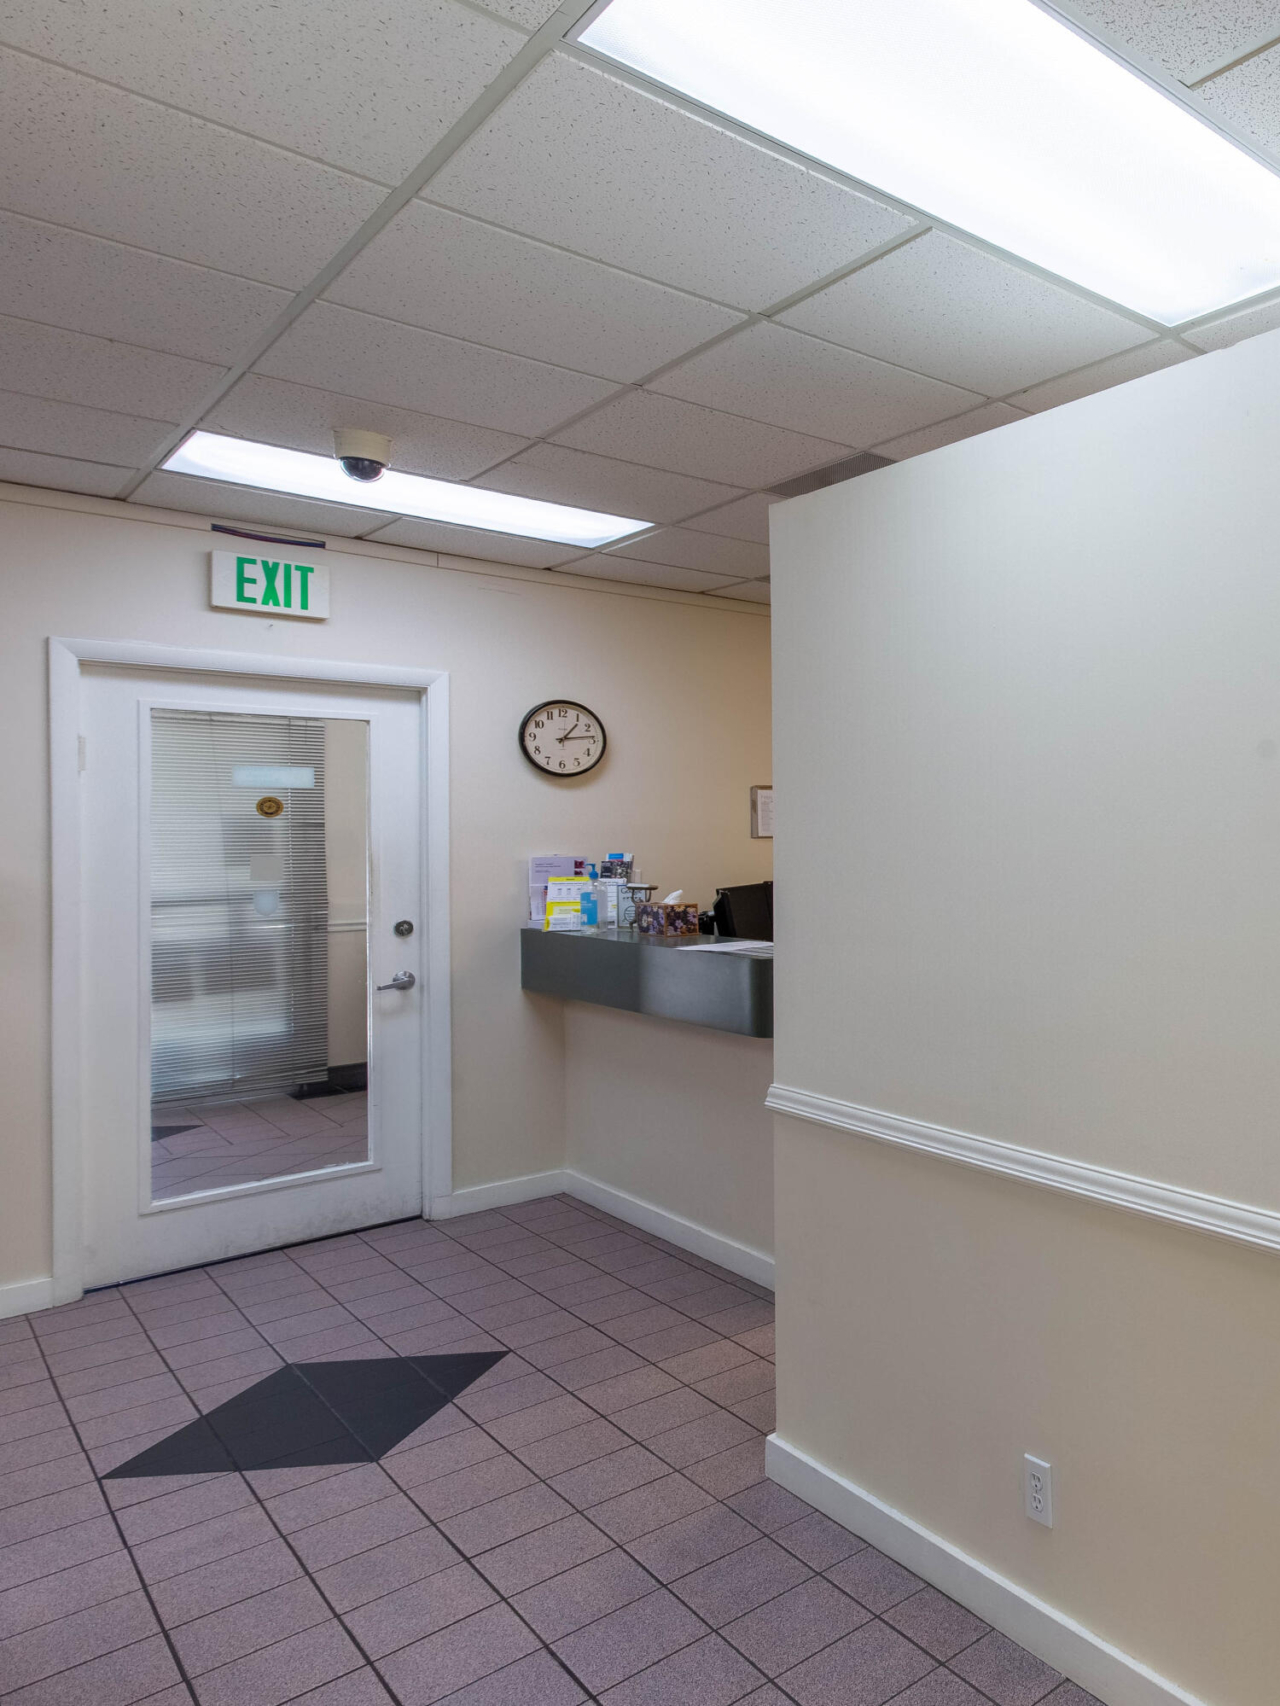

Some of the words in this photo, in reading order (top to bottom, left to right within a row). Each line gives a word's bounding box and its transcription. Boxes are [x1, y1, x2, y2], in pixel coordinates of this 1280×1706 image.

[236, 556, 314, 610] EXIT
[546, 711, 553, 720] 11
[558, 709, 567, 718] 12
[576, 713, 580, 722] 1
[534, 720, 544, 729] 10
[584, 723, 591, 732] 2
[529, 732, 536, 741] 9
[588, 736, 596, 745] 3
[534, 746, 541, 755] 8
[583, 748, 591, 757] 4
[545, 757, 551, 765] 7
[558, 760, 566, 769] 6
[573, 758, 580, 767] 5
